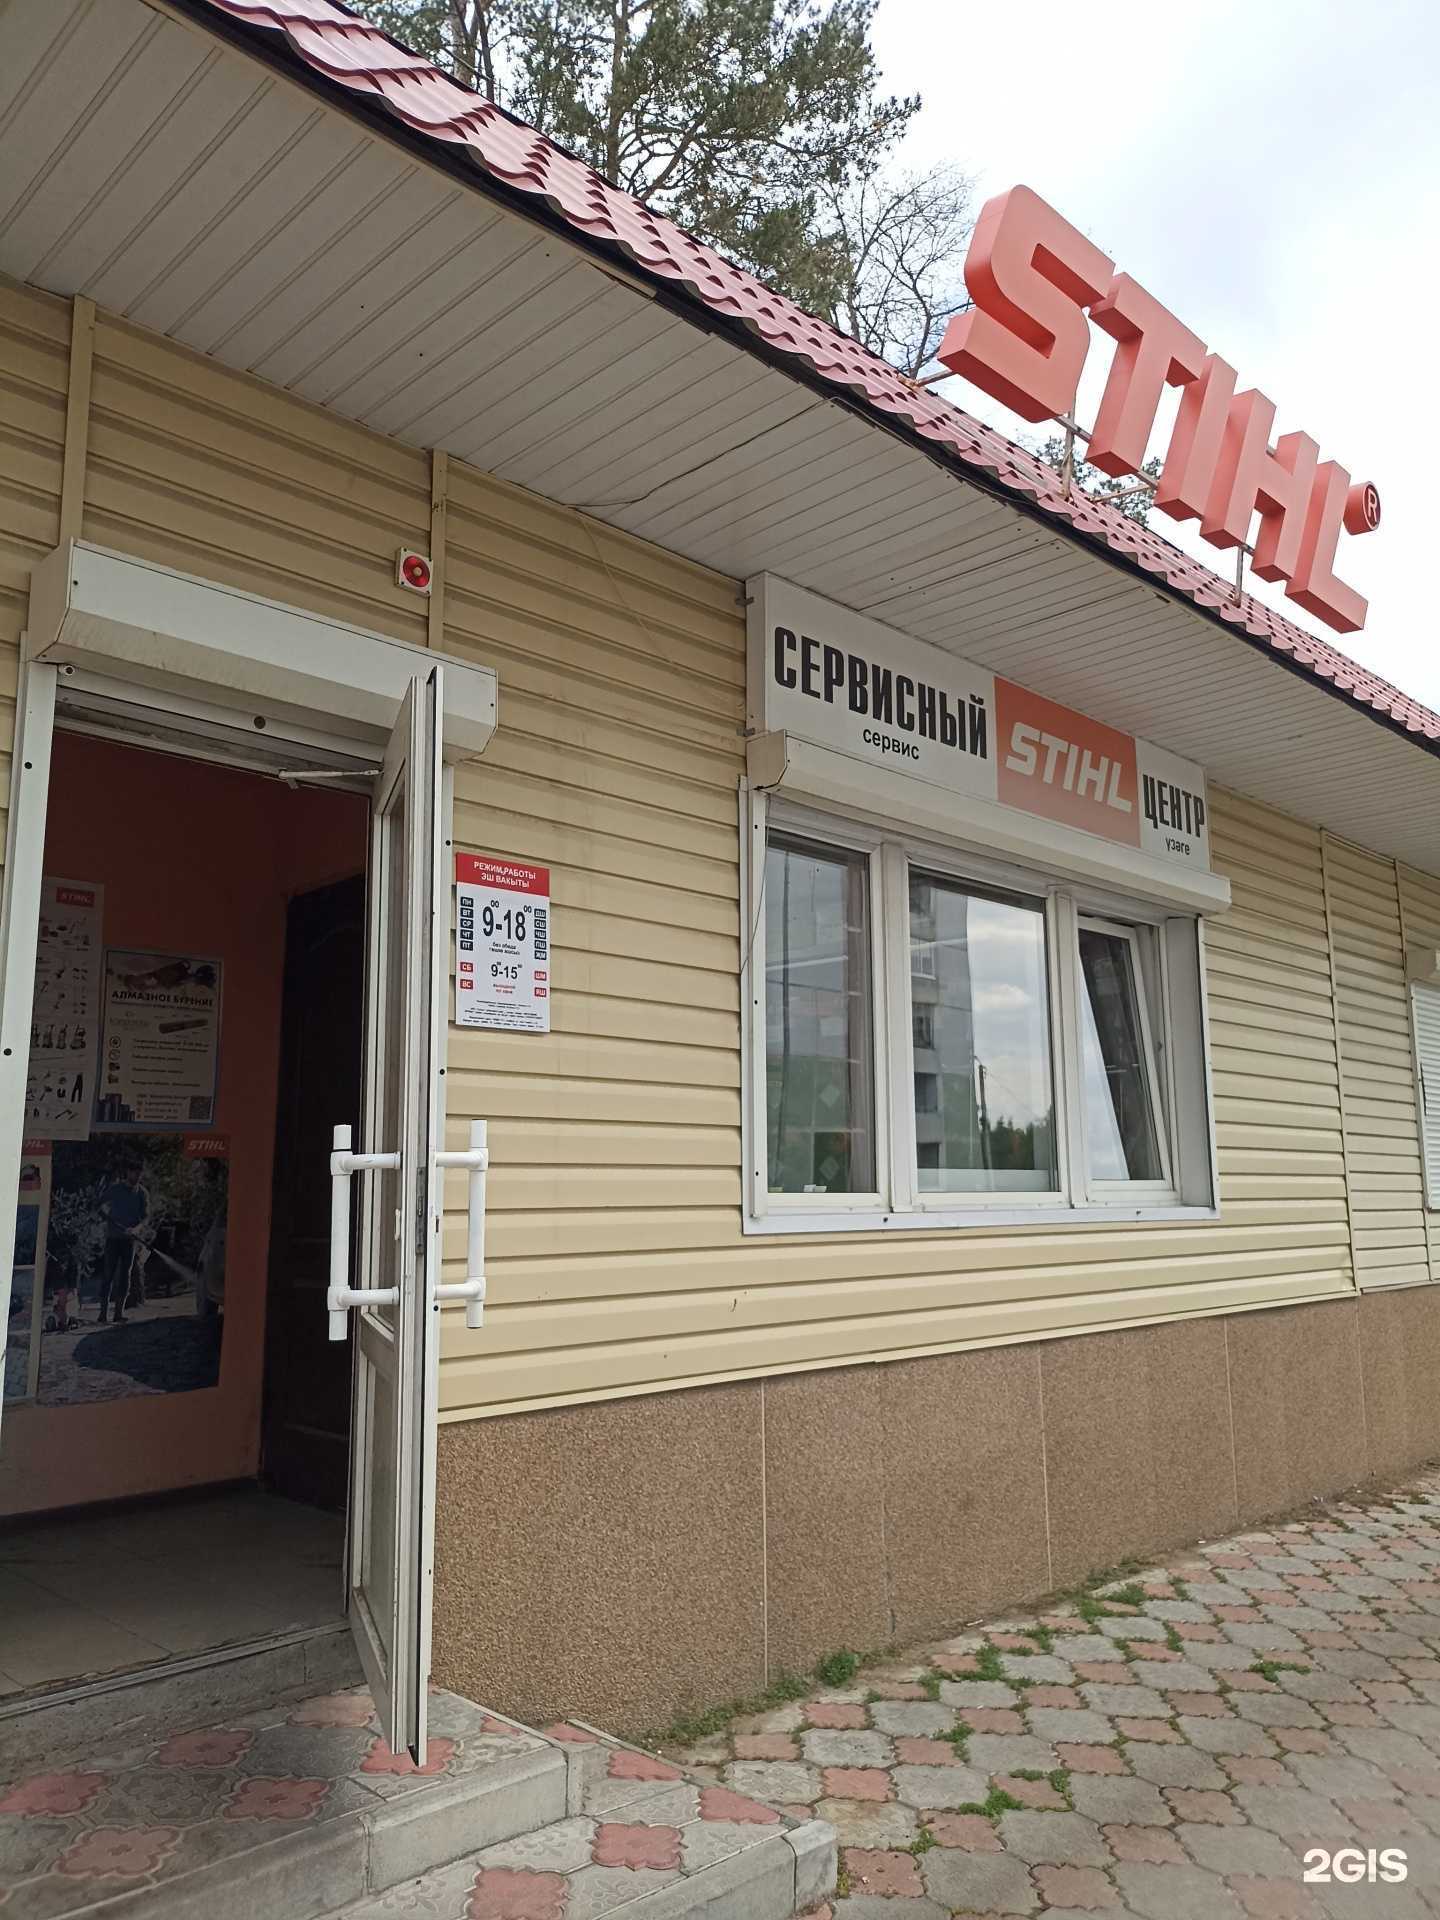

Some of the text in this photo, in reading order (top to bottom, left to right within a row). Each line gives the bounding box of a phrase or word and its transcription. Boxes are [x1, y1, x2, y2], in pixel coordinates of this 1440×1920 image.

[774, 626, 1205, 838] СЕРВИСНЫЙ STIHL ЦЕНТР
[863, 728, 919, 760] сервис
[474, 861, 536, 879] РЕЖИМ РАБОТЫ
[481, 872, 530, 888] ЭШ ВАКЫТЫ
[111, 990, 171, 1002] АЛМАЗНОЕ
[187, 1139, 225, 1151] STIHL
